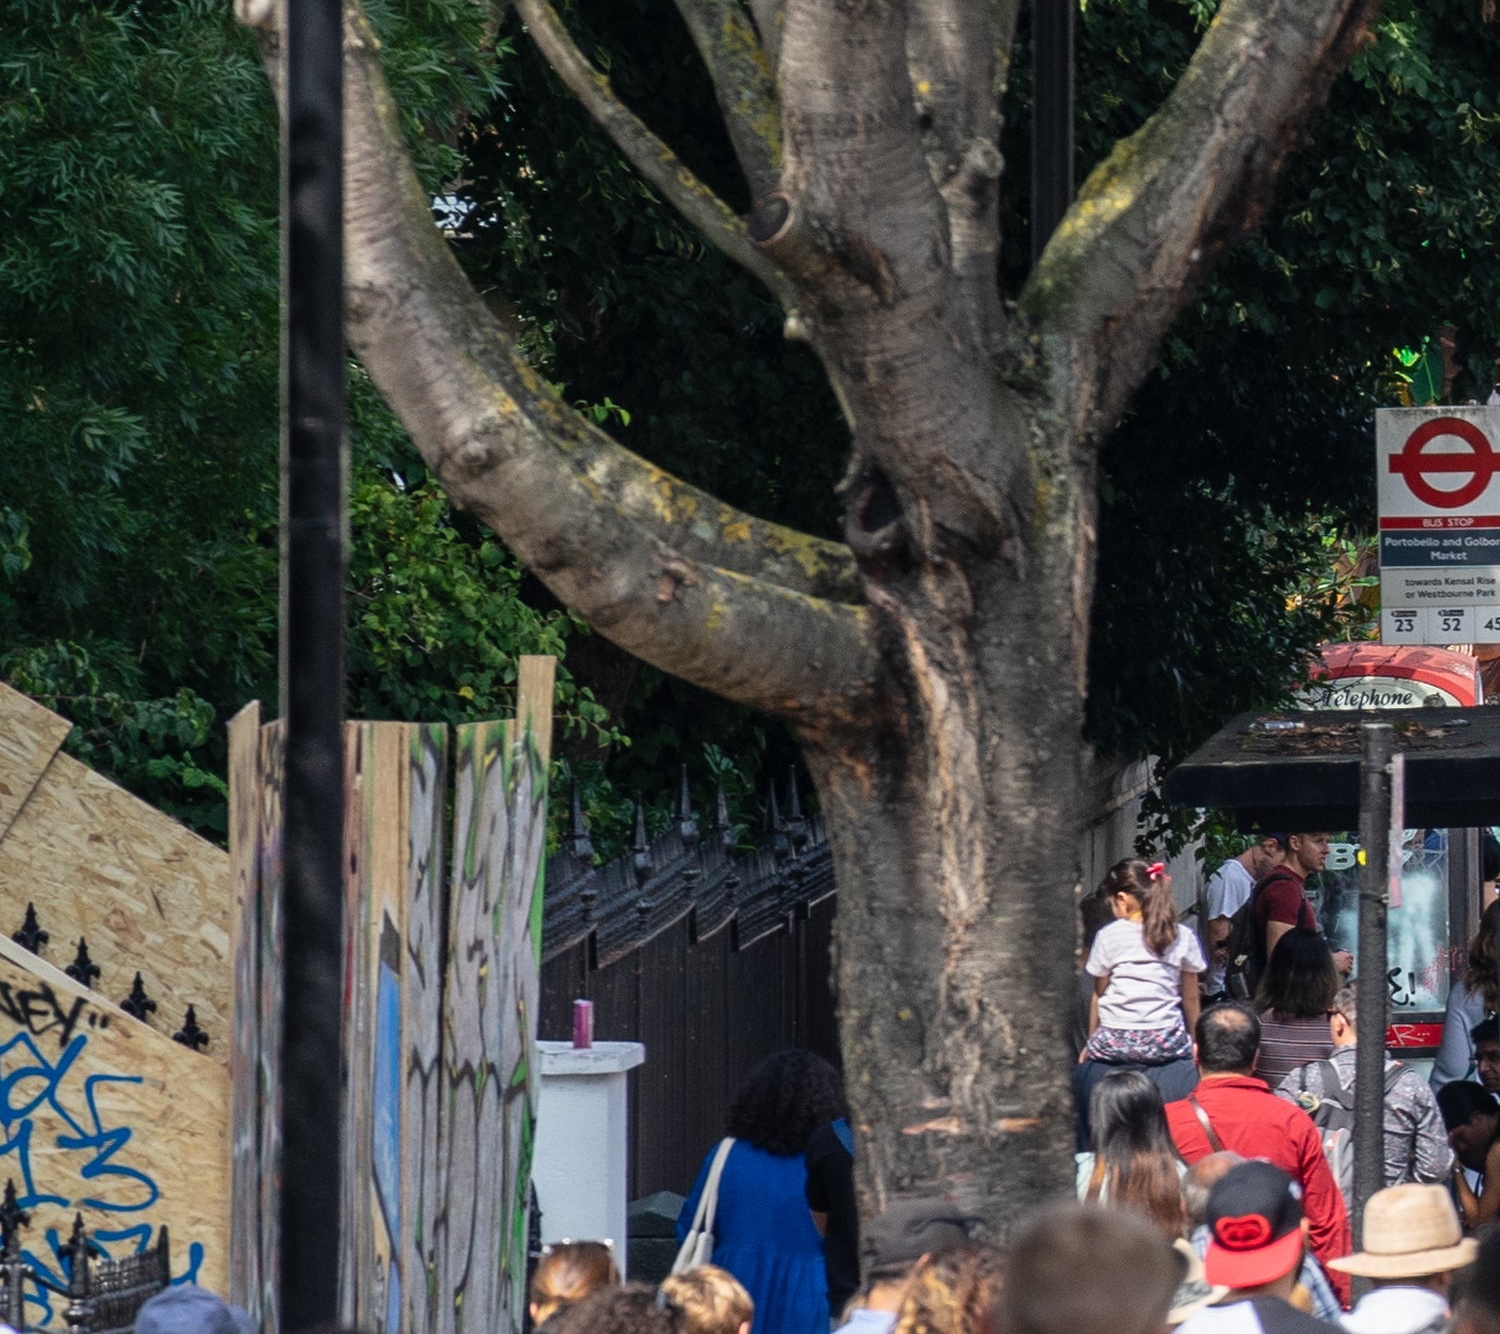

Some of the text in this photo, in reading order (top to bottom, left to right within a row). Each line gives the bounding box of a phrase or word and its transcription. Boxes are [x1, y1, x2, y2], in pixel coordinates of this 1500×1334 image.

[1422, 517, 1475, 527] BUS STOP
[1384, 536, 1440, 547] Portobello
[1441, 537, 1462, 547] and
[1430, 551, 1468, 561] Market
[1405, 576, 1496, 587] towards Kensal Rise
[1405, 589, 1496, 599] or Westbourne Park
[1394, 618, 1415, 633] 23
[1441, 617, 1462, 632] 52
[1322, 688, 1413, 710] Telephone
